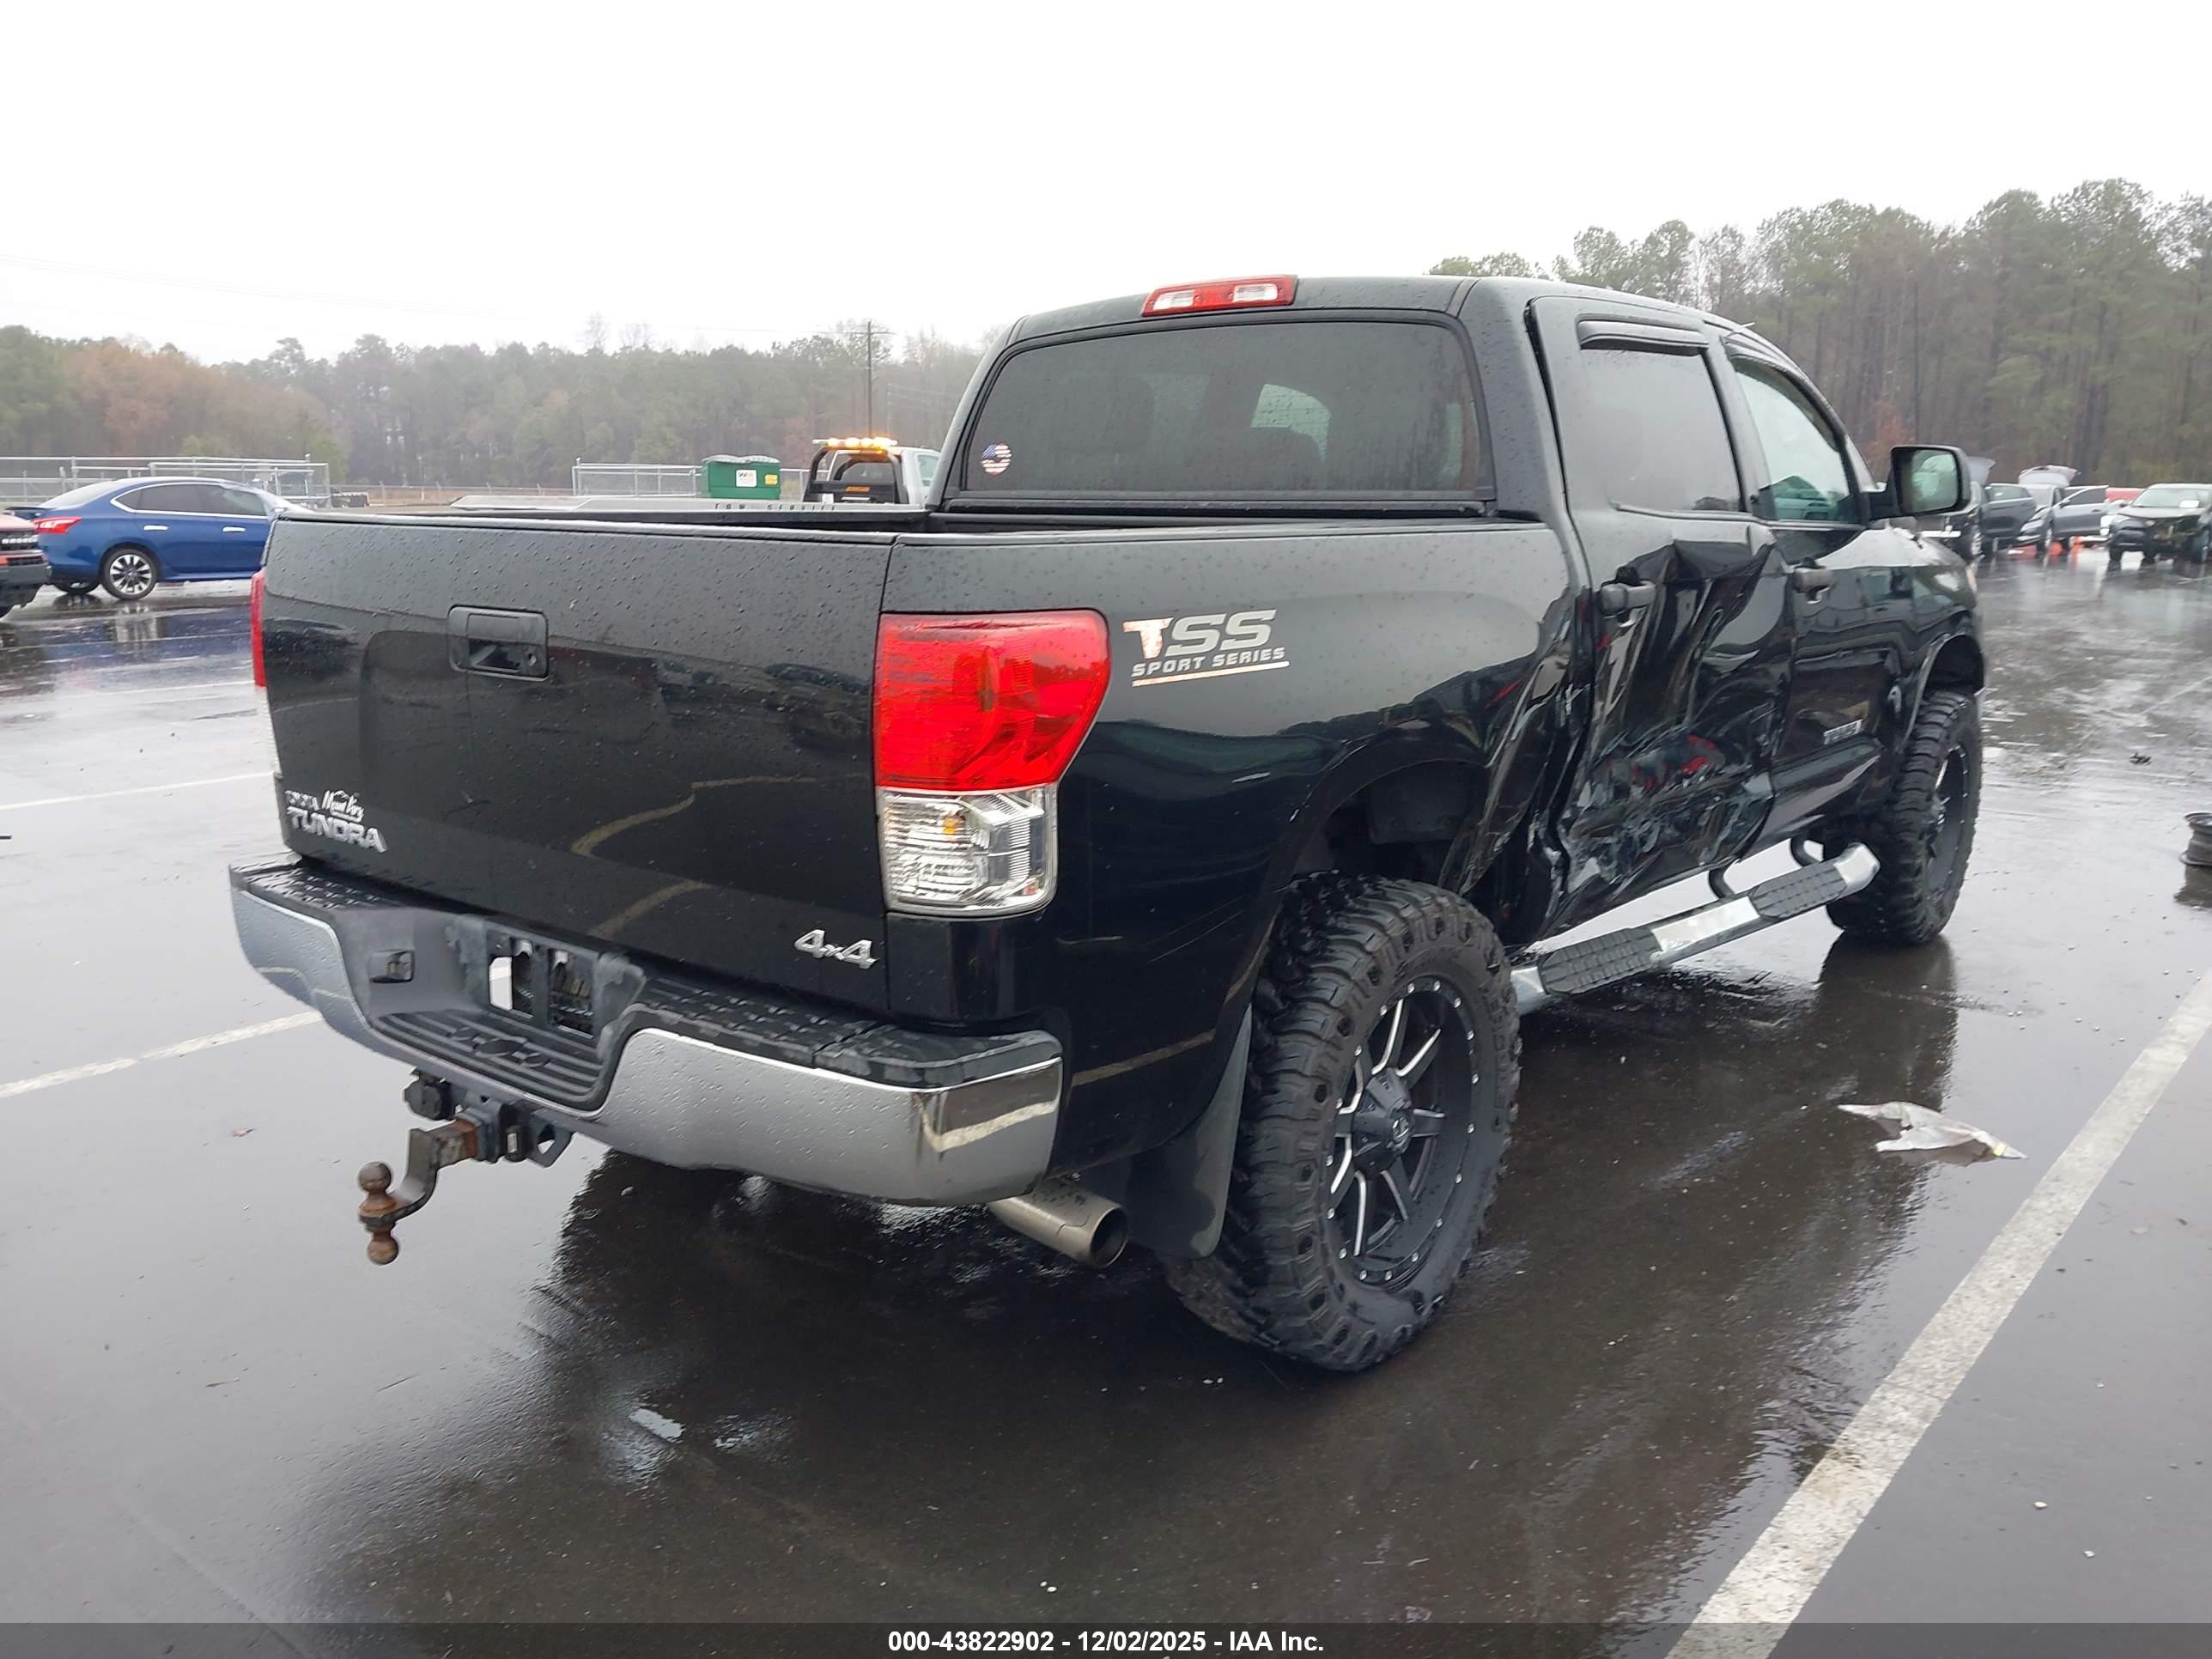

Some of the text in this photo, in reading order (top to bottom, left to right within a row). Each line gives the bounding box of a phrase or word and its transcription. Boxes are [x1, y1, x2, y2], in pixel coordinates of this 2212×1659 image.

[1122, 609, 1278, 659] TSS
[1131, 647, 1286, 678] SPORT SERIES
[287, 805, 387, 853] TUNDRA
